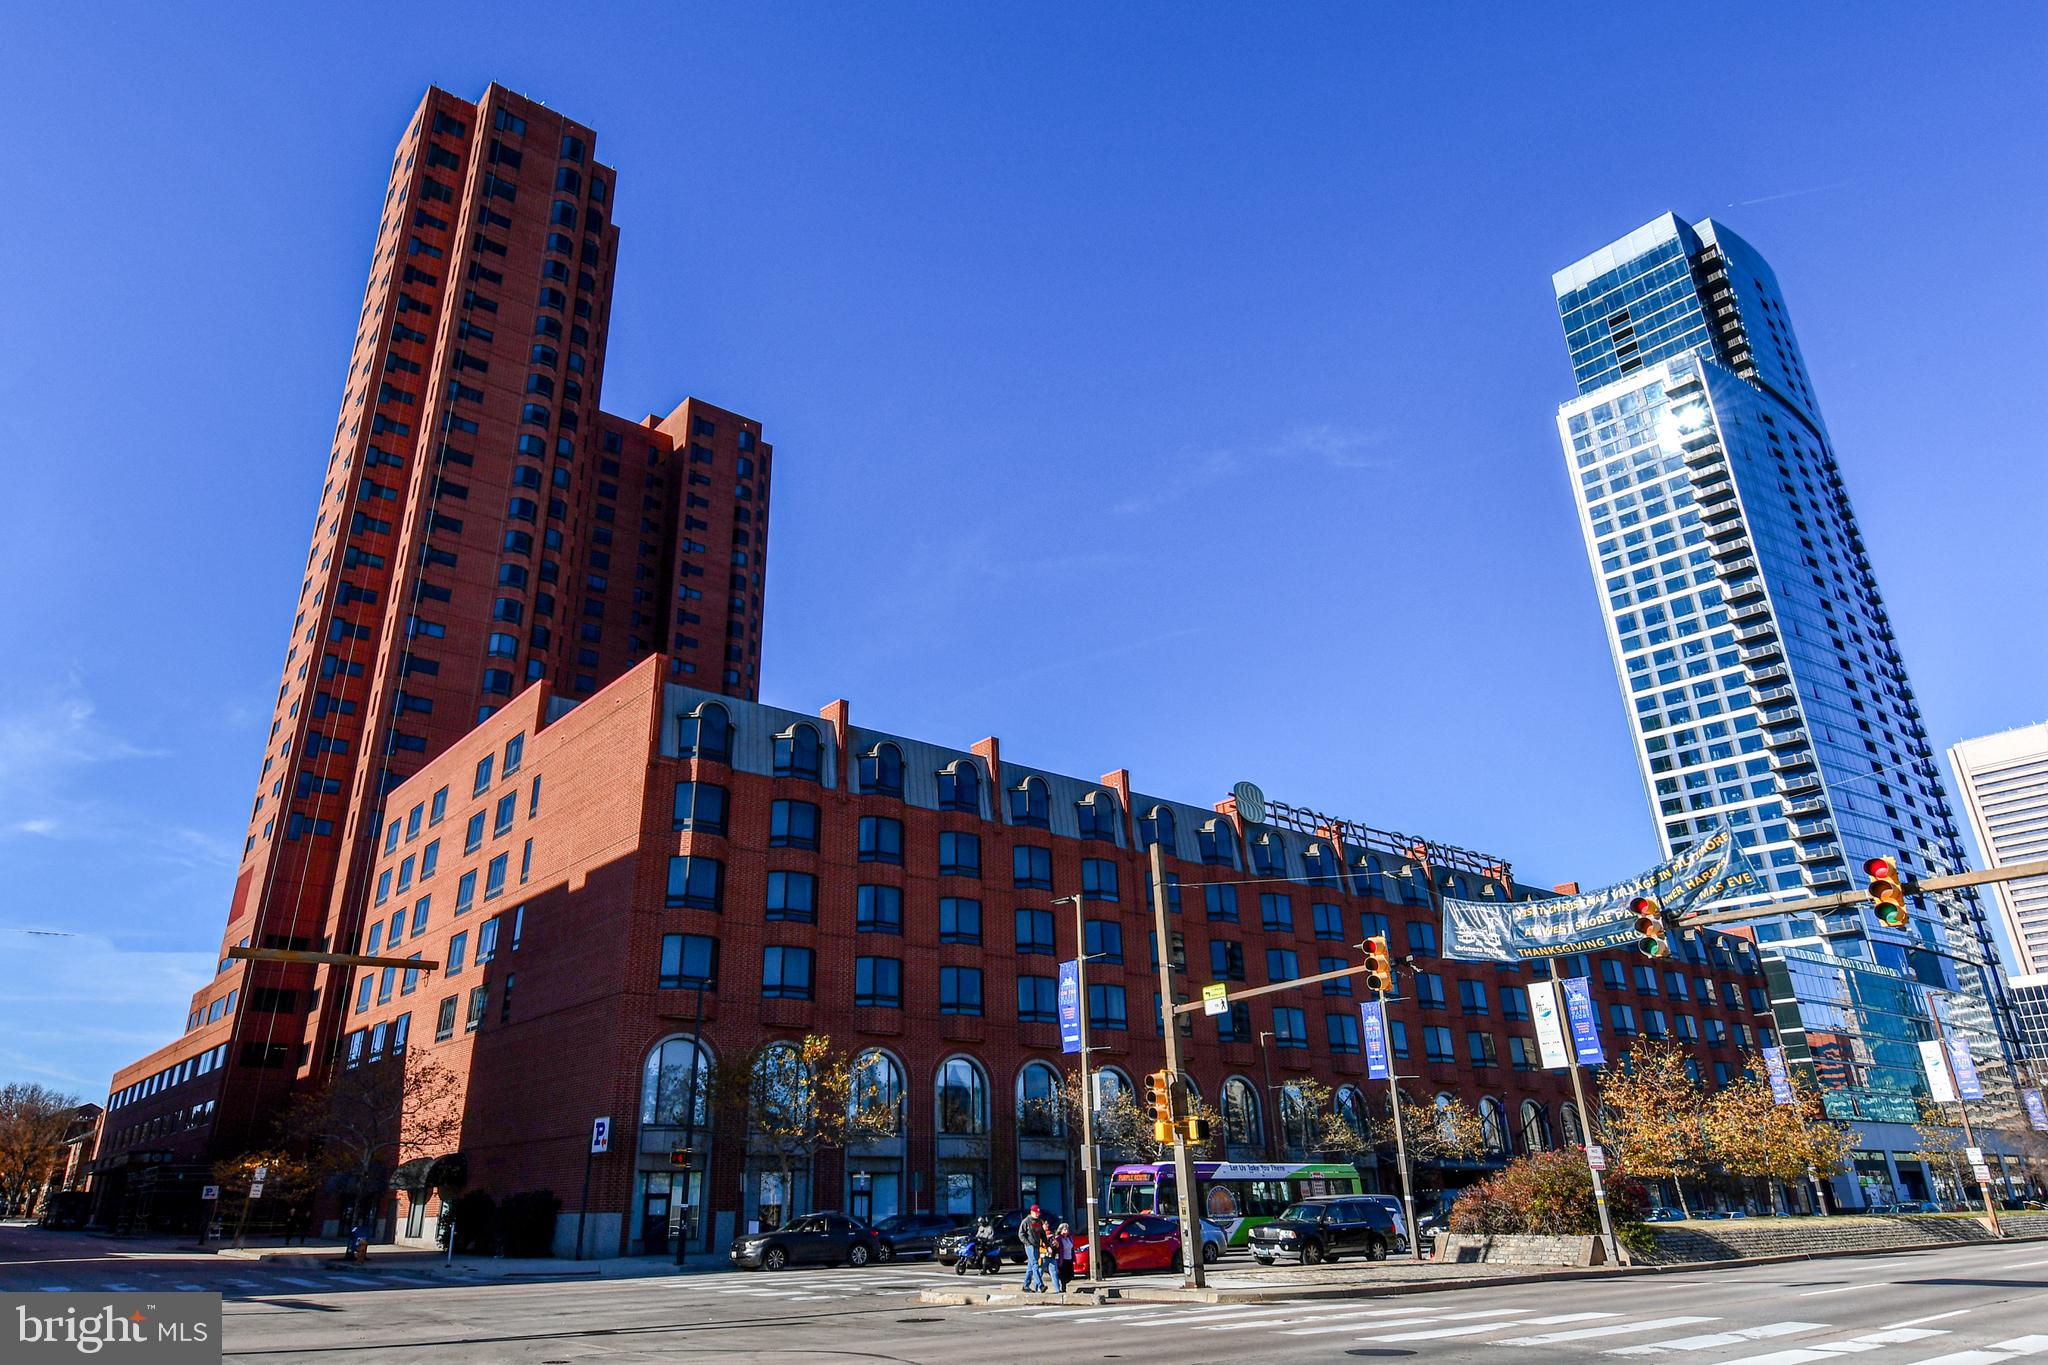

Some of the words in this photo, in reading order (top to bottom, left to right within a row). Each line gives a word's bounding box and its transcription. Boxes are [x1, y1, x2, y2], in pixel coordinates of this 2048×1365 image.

[1272, 800, 1378, 849] ROYAL
[1390, 831, 1514, 885] SONESTA
[1612, 876, 1658, 901] VILLAGE
[1657, 868, 1672, 882] IN
[1517, 937, 1606, 957] THANKSGIVING
[1607, 930, 1644, 945] THRO
[1726, 872, 1753, 888] EVE
[1542, 922, 1572, 937] WEST
[1575, 913, 1613, 931] SHORE
[1615, 907, 1638, 921] PA
[1661, 884, 1686, 907] NNER
[594, 1122, 606, 1146] P
[1247, 1164, 1260, 1172] Take
[1260, 1164, 1270, 1172] You
[1270, 1164, 1286, 1172] There
